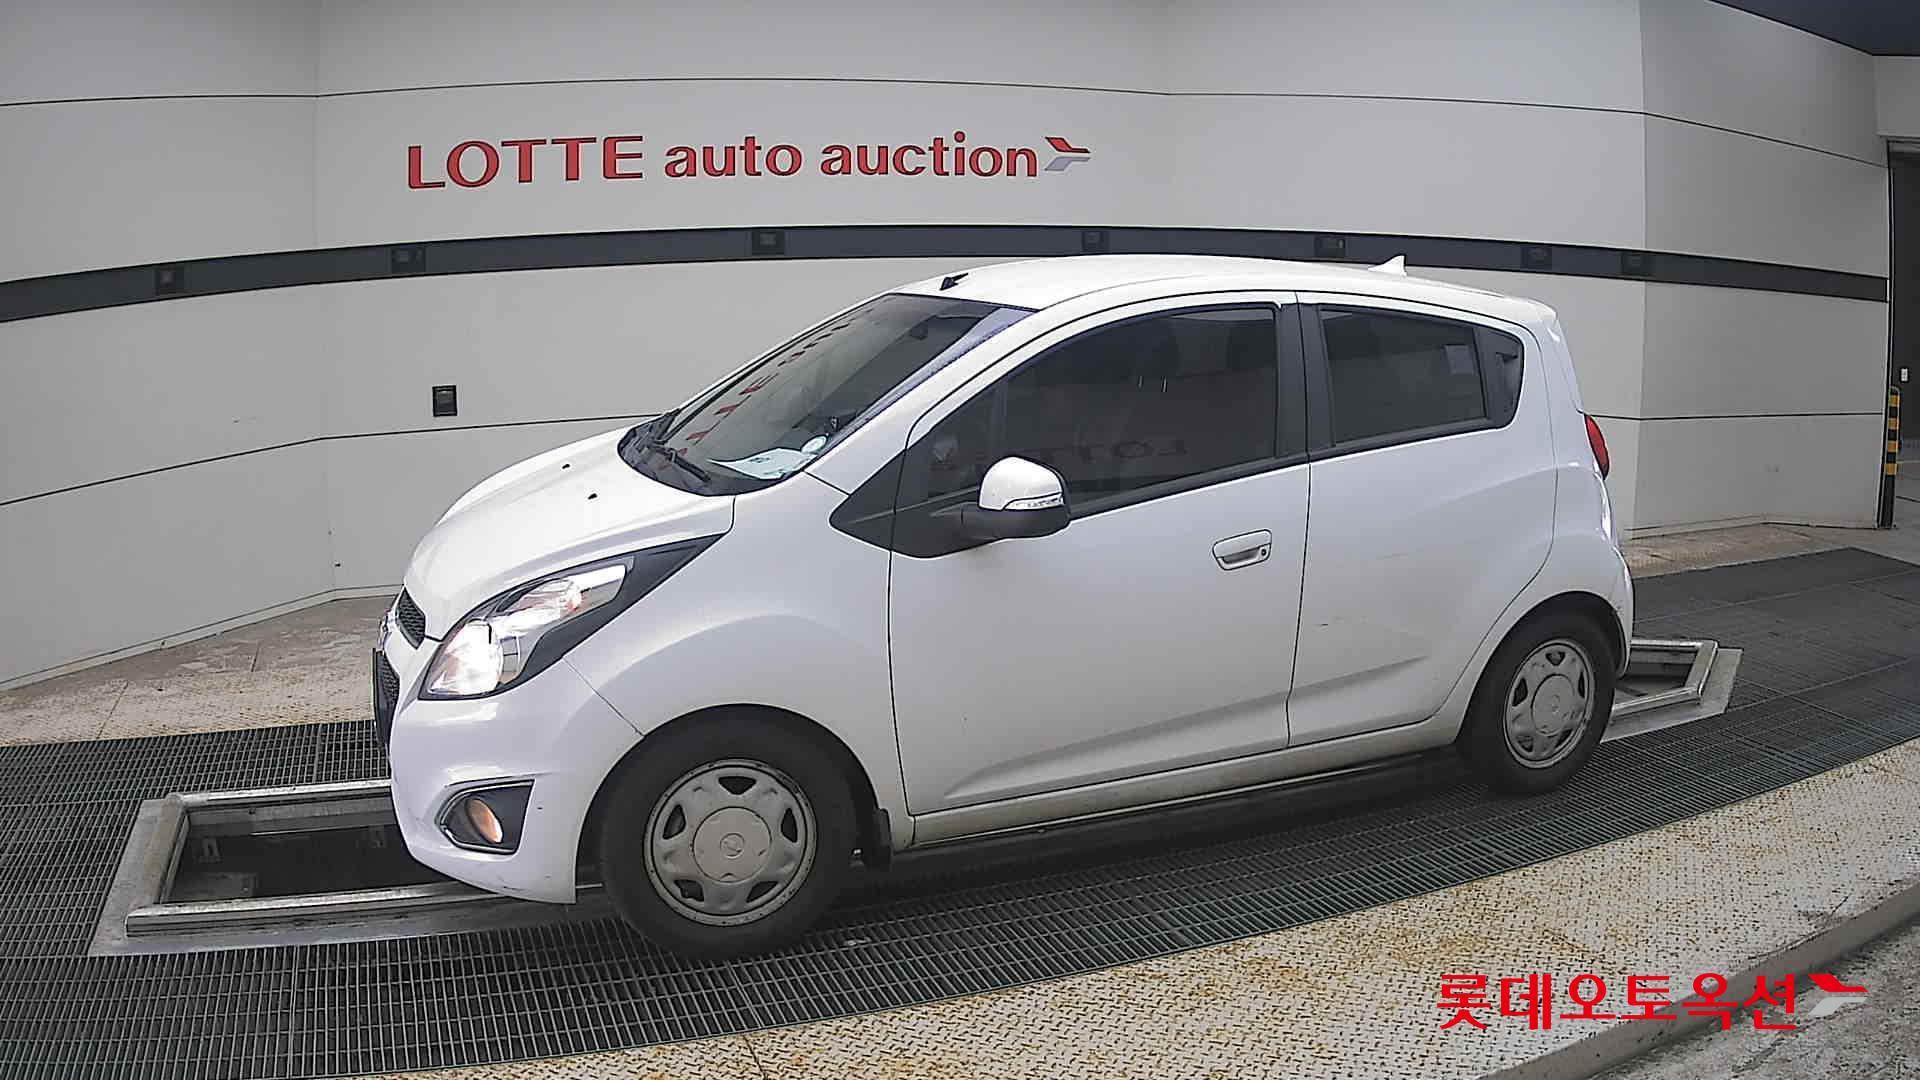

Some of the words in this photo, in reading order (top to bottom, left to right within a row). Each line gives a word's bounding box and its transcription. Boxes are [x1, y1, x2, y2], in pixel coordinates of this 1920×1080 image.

[408, 135, 643, 190] LOTTE
[664, 136, 803, 178] auto
[820, 131, 1038, 178] auction
